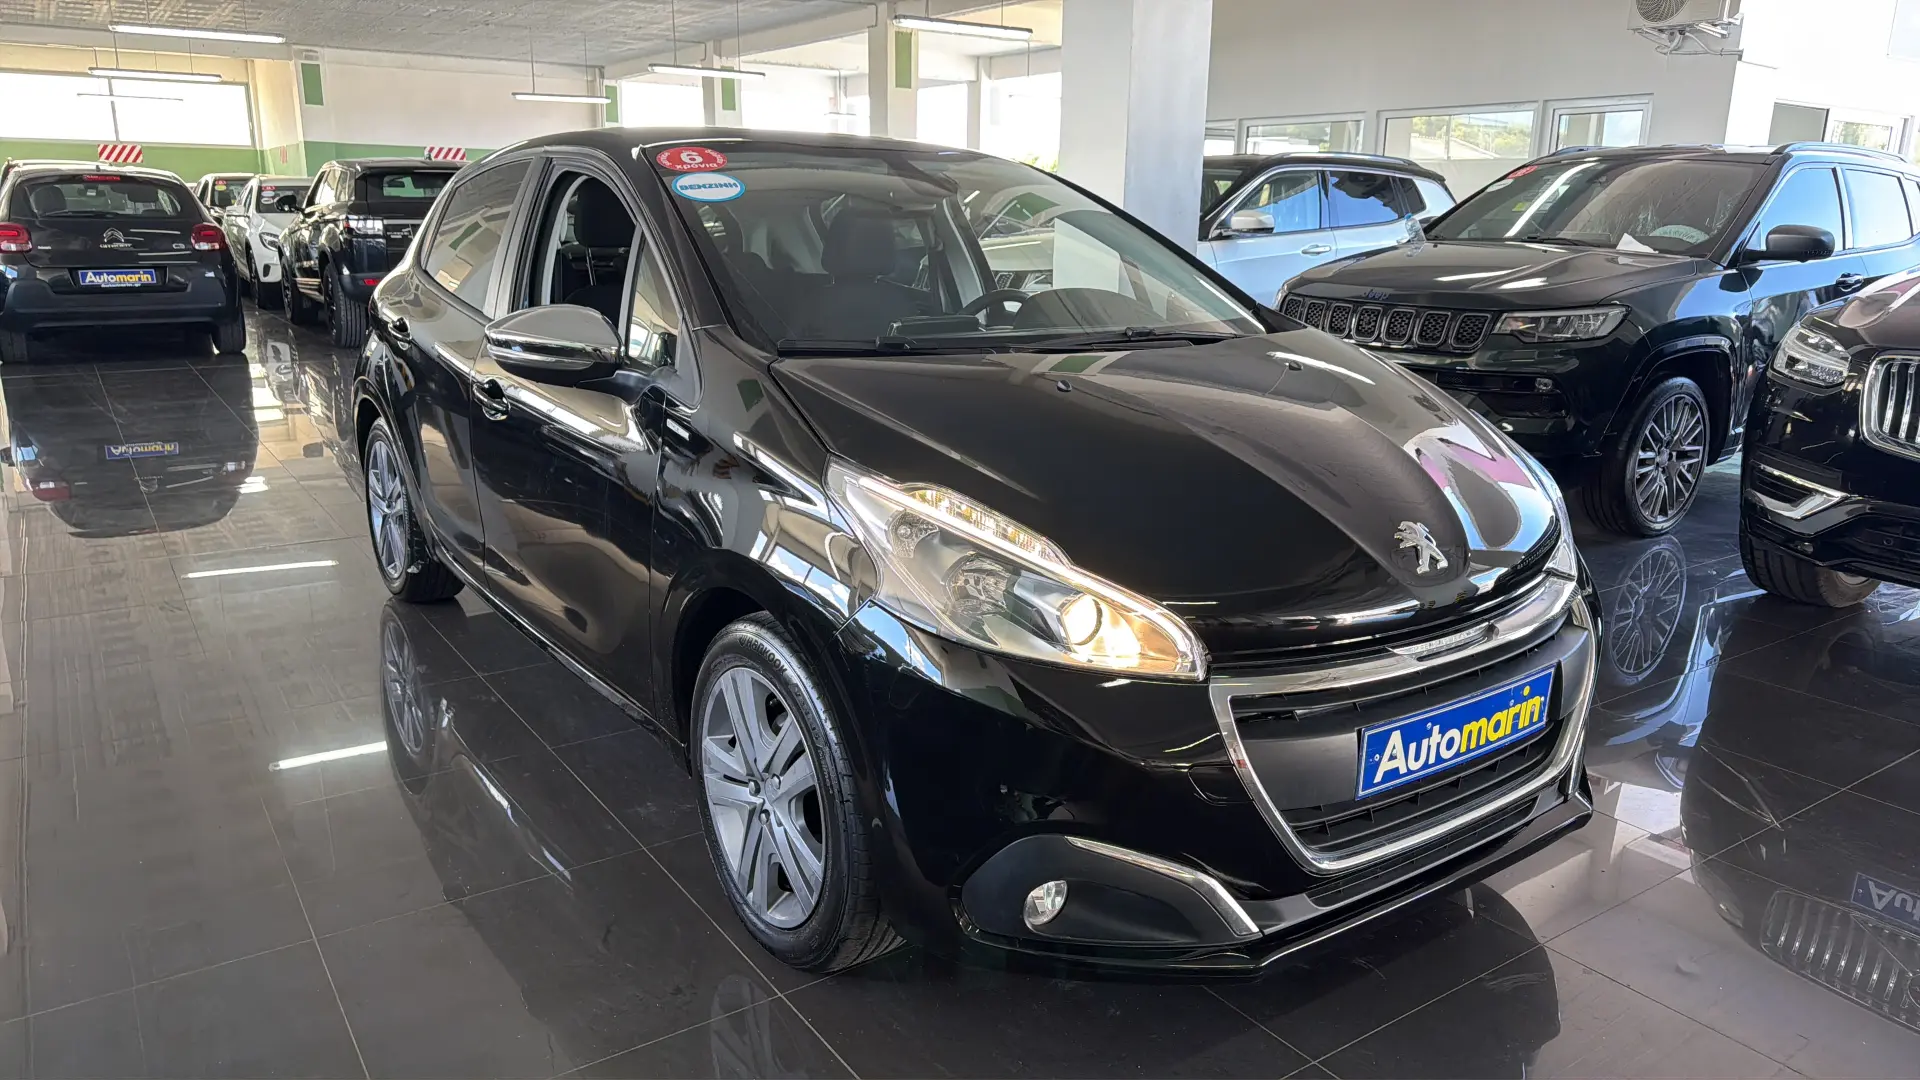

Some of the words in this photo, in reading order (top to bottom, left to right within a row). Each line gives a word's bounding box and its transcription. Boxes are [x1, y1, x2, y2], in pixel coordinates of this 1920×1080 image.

[680, 152, 703, 164] 6
[85, 271, 151, 283] Automarin
[1373, 685, 1542, 784] Automarin
